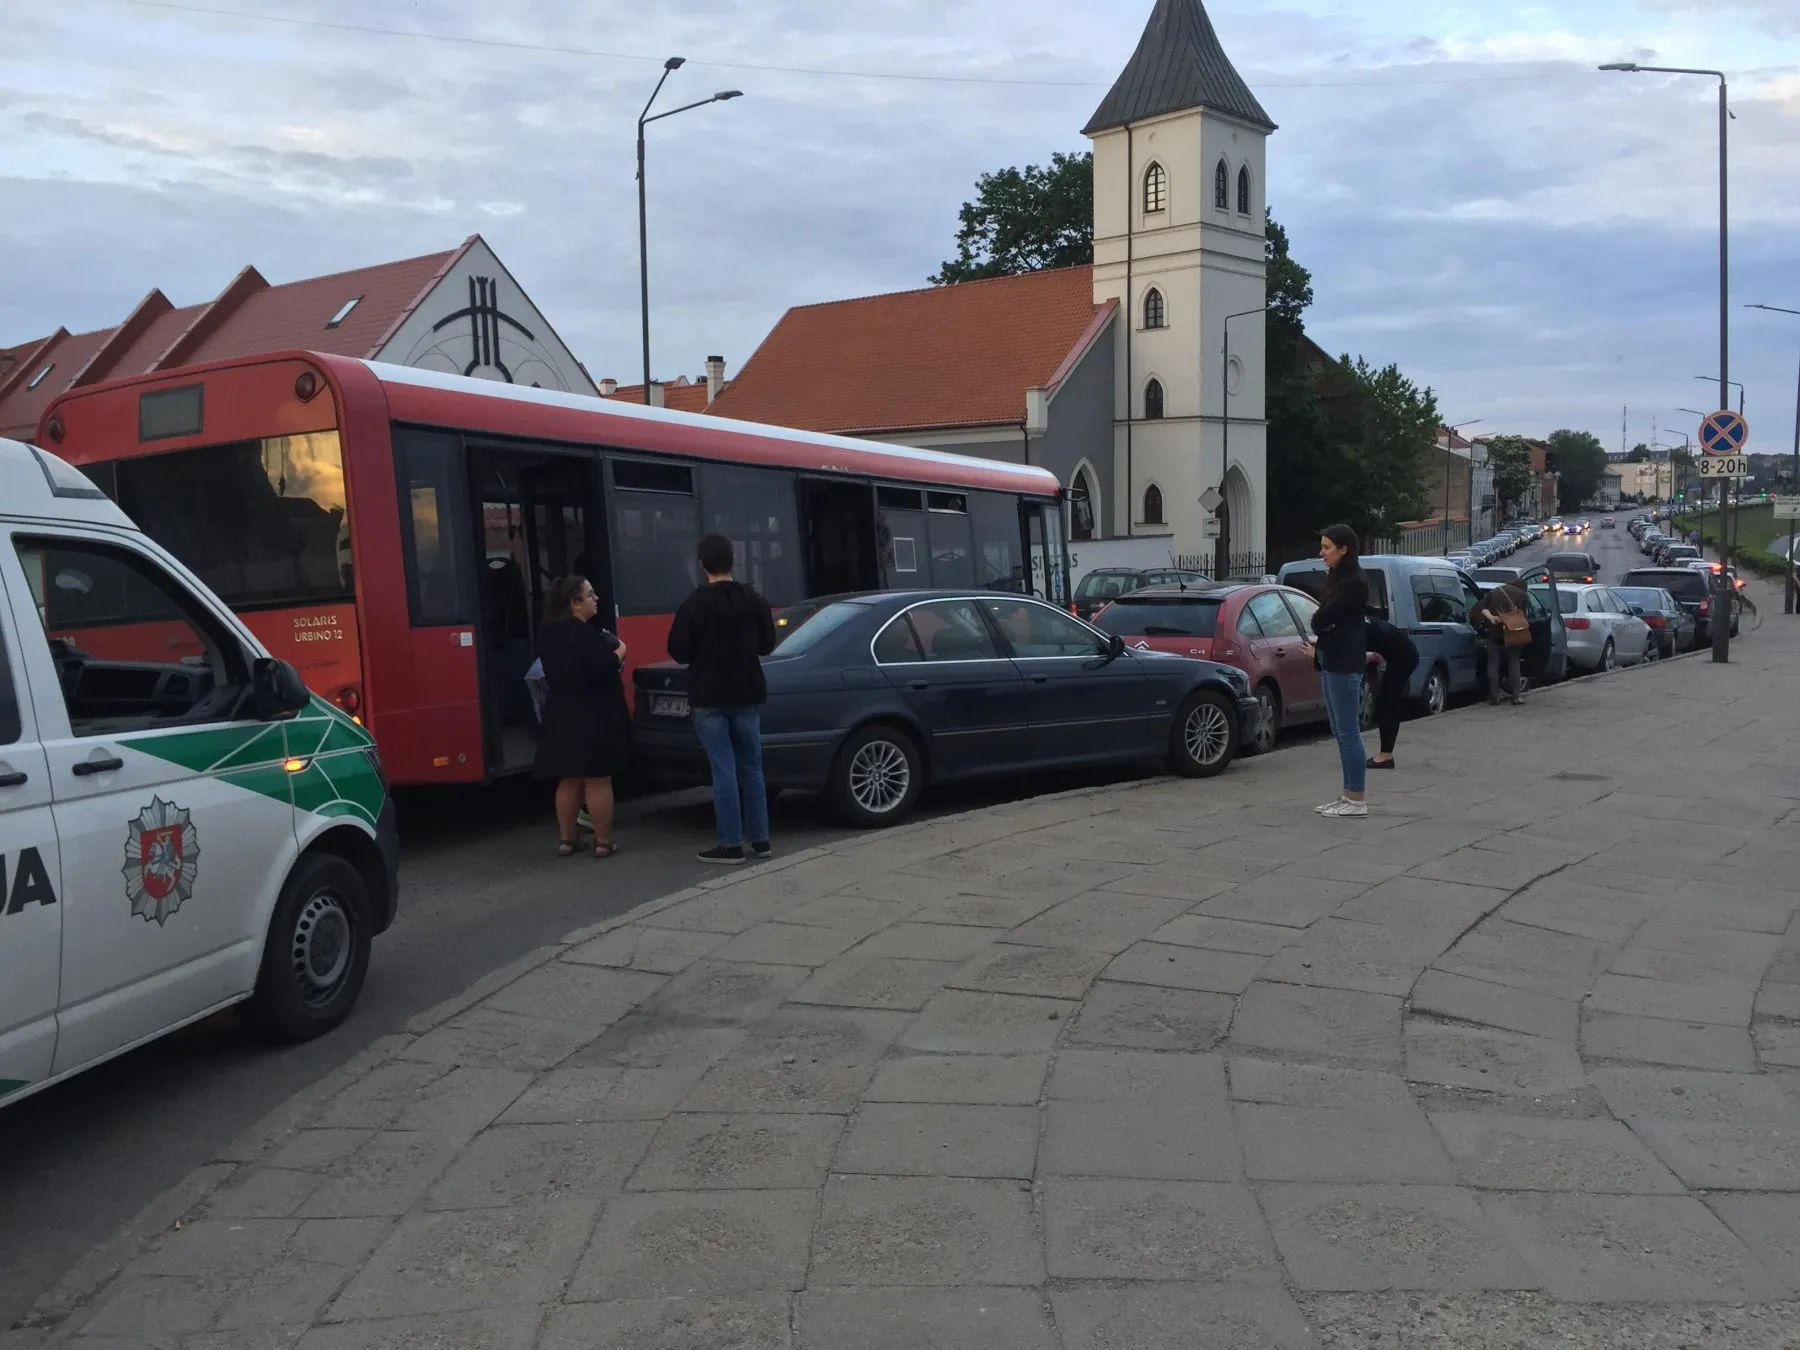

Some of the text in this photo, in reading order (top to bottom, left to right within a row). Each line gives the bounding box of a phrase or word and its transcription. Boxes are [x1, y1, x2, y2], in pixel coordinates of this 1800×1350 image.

[294, 615, 337, 628] SOLARIS
[294, 629, 343, 642] URBINO 12
